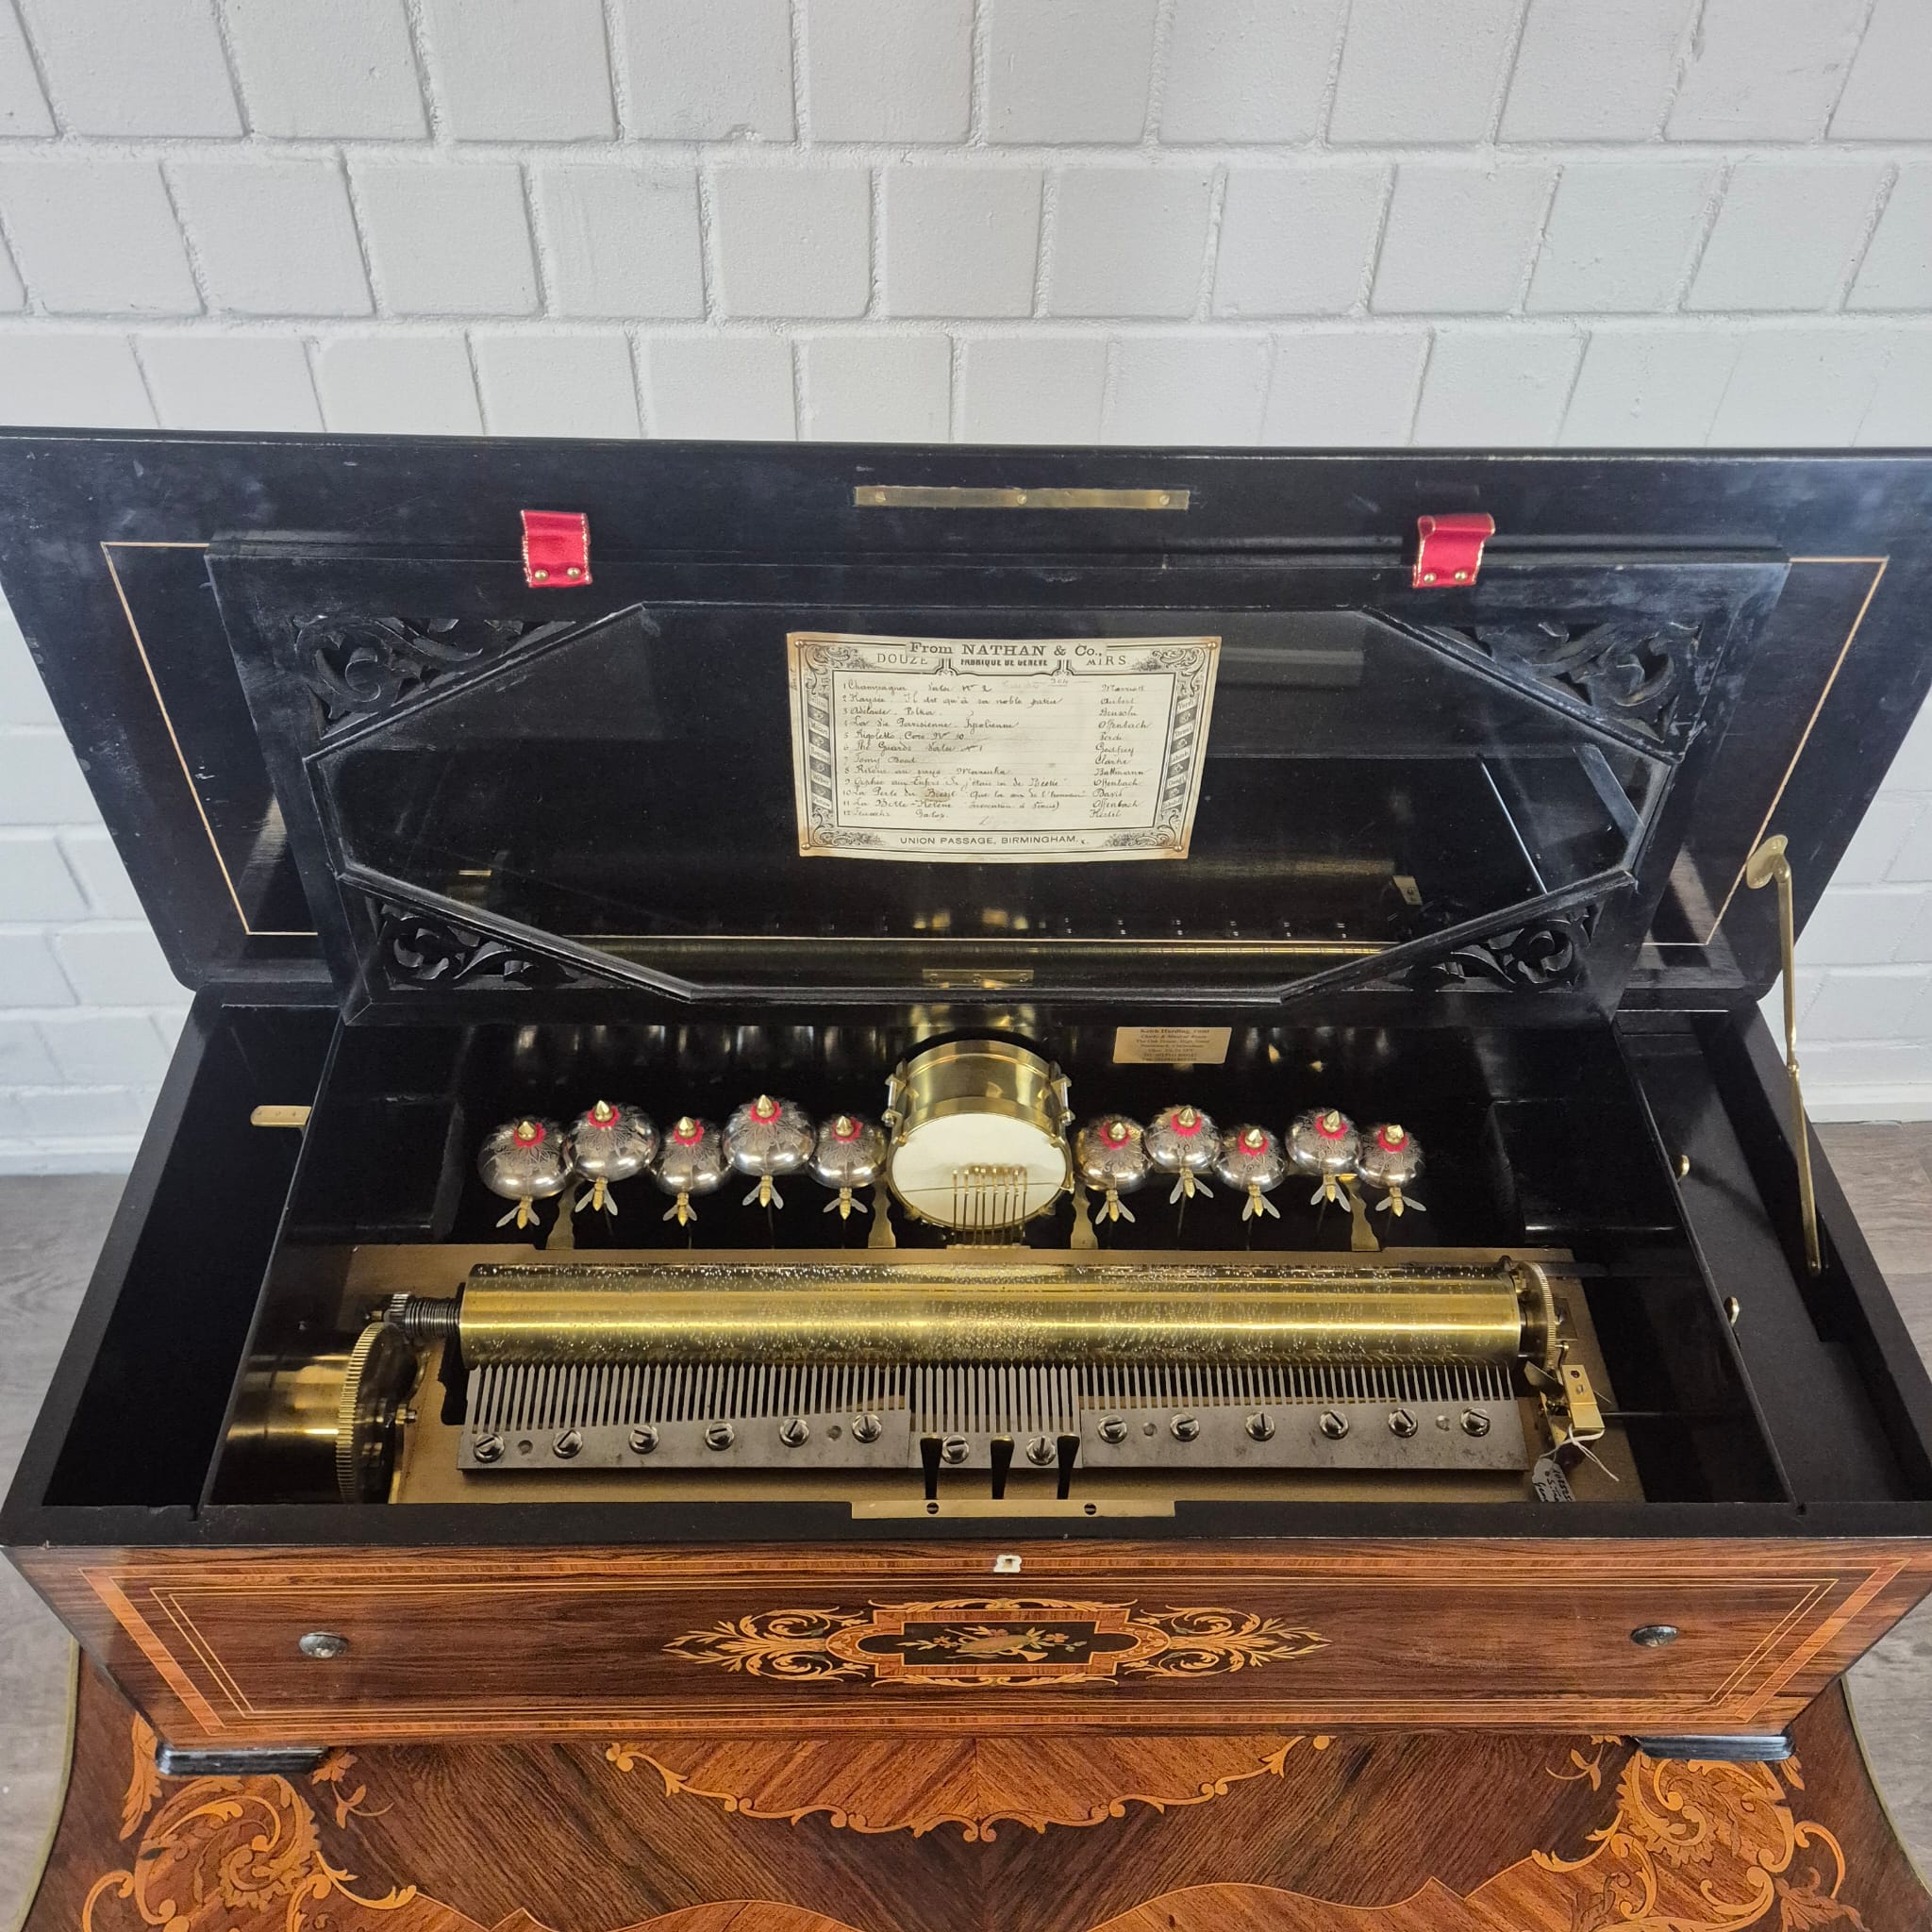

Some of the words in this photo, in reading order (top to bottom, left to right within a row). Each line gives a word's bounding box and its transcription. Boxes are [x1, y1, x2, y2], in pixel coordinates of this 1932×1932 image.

[909, 641, 954, 655] From
[960, 643, 1047, 657] NATHAN
[1053, 645, 1066, 657] &
[900, 836, 936, 845] UNION
[940, 837, 997, 847] PASSAGE,
